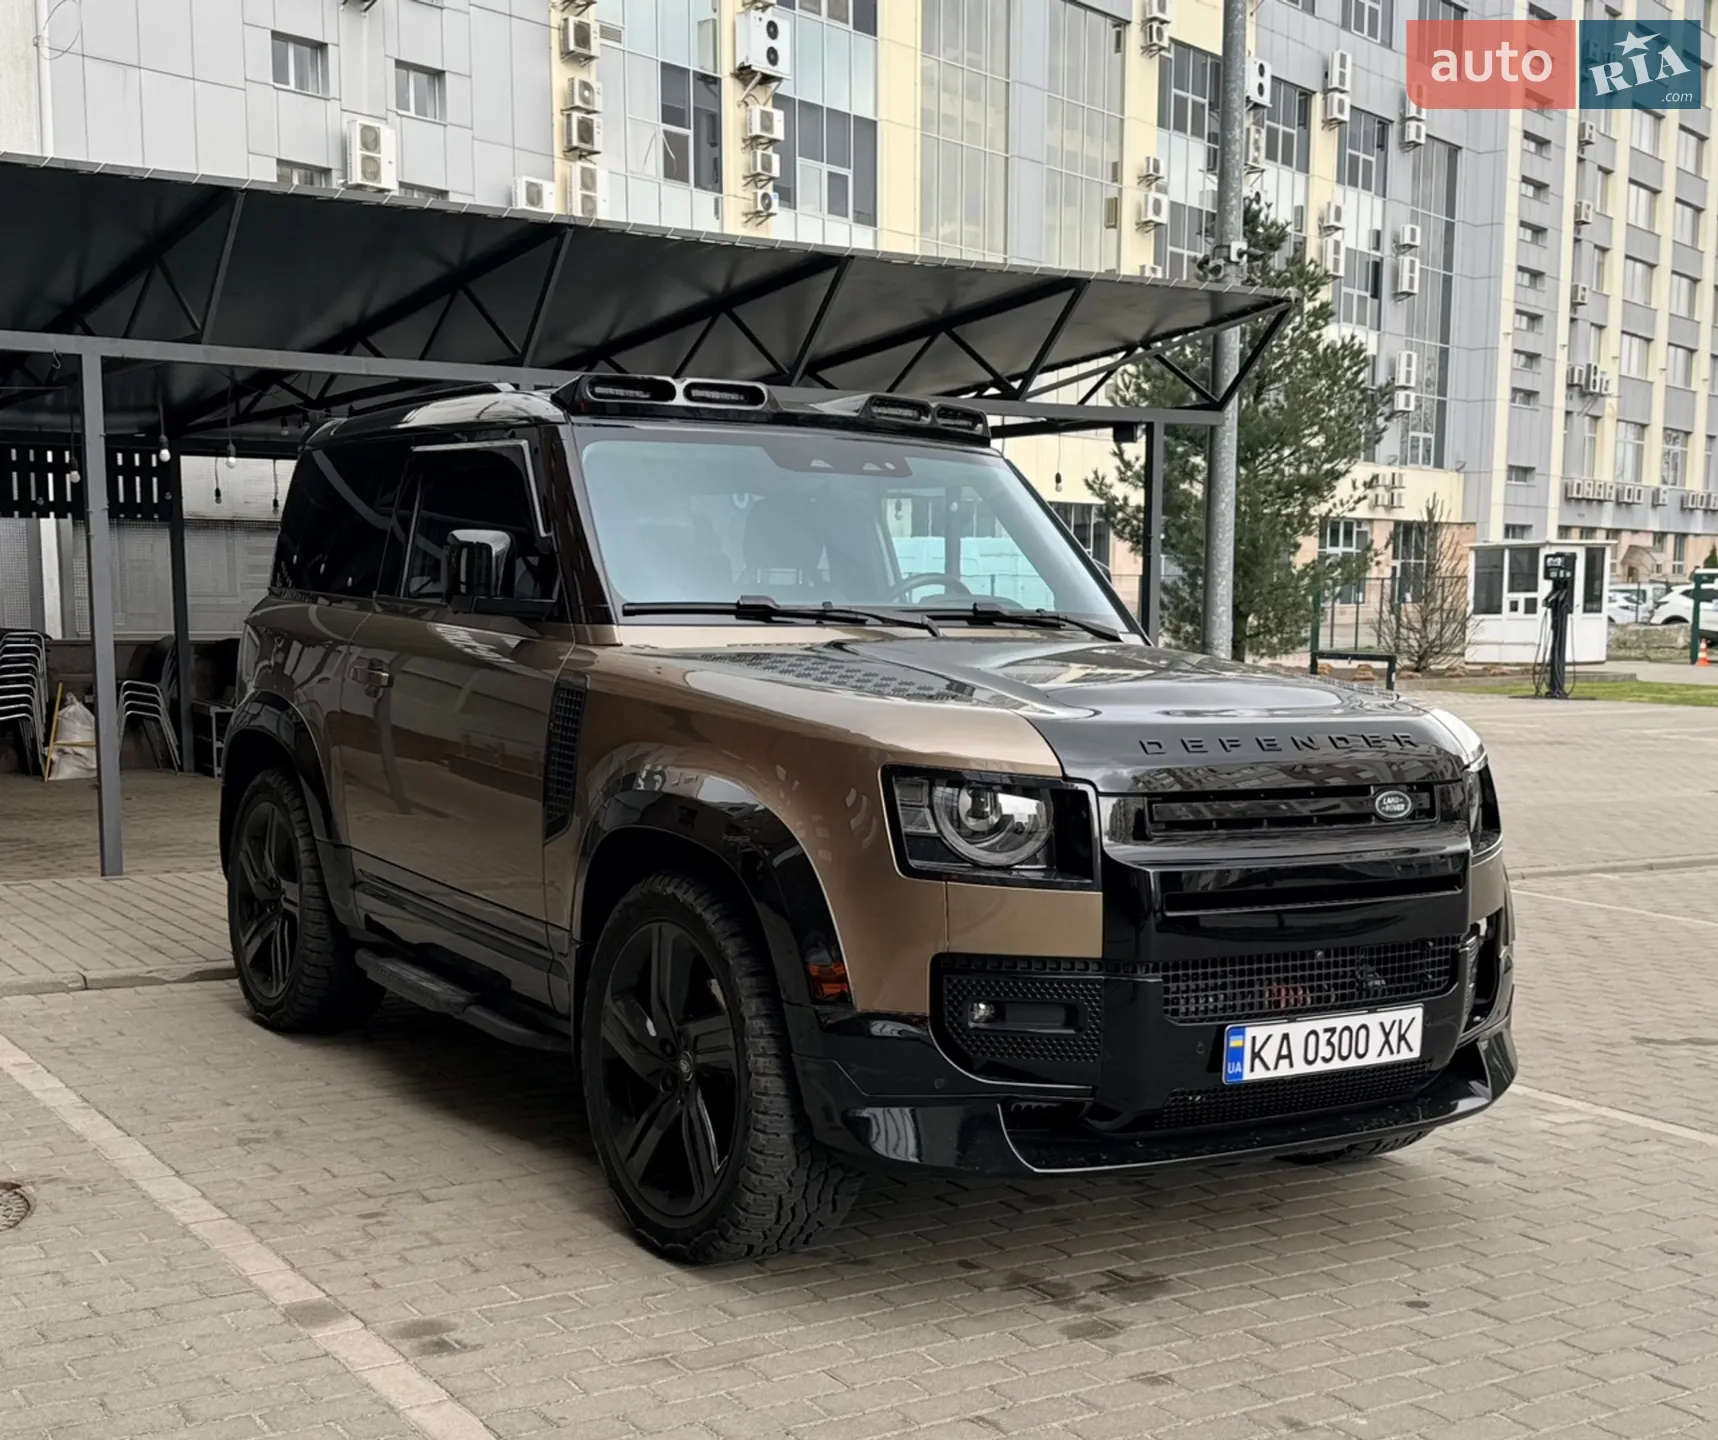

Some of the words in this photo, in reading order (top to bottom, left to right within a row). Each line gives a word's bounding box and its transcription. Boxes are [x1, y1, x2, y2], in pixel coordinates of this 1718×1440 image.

[1139, 732, 1419, 756] DEFENDER
[1250, 1032, 1294, 1073] KA
[1303, 1023, 1370, 1066] 0300
[1377, 1016, 1416, 1058] XK
[1227, 1062, 1242, 1074] UA
